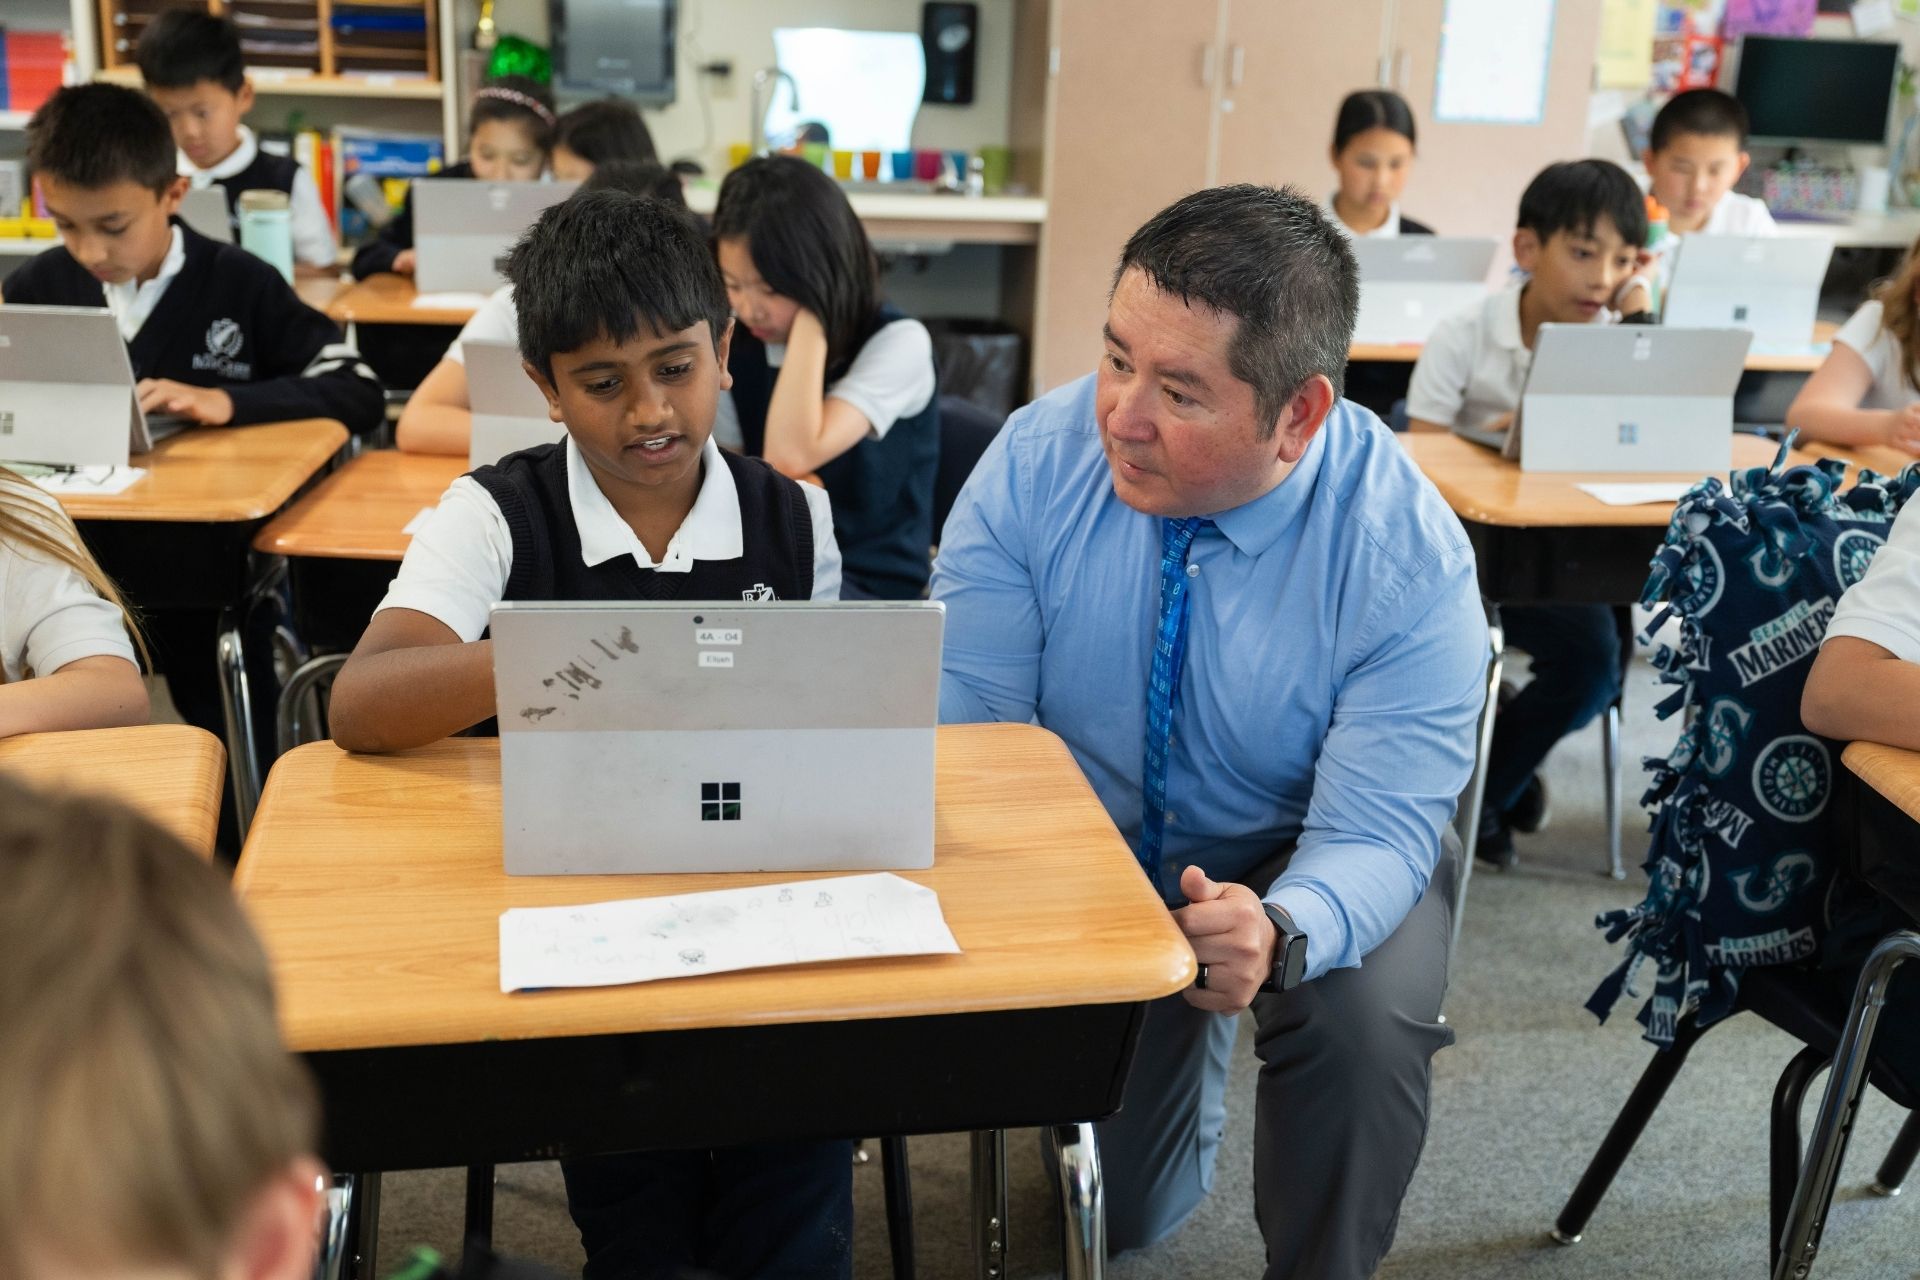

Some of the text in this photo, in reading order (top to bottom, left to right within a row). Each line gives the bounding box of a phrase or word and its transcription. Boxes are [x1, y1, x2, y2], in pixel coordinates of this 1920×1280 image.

[700, 633, 714, 641] 4A
[725, 633, 738, 641] 04
[1752, 601, 1809, 642] SEATTLE
[1734, 602, 1834, 682] MARINERS
[1705, 932, 1813, 967] MARINERS
[1723, 930, 1787, 950] SEATTLE
